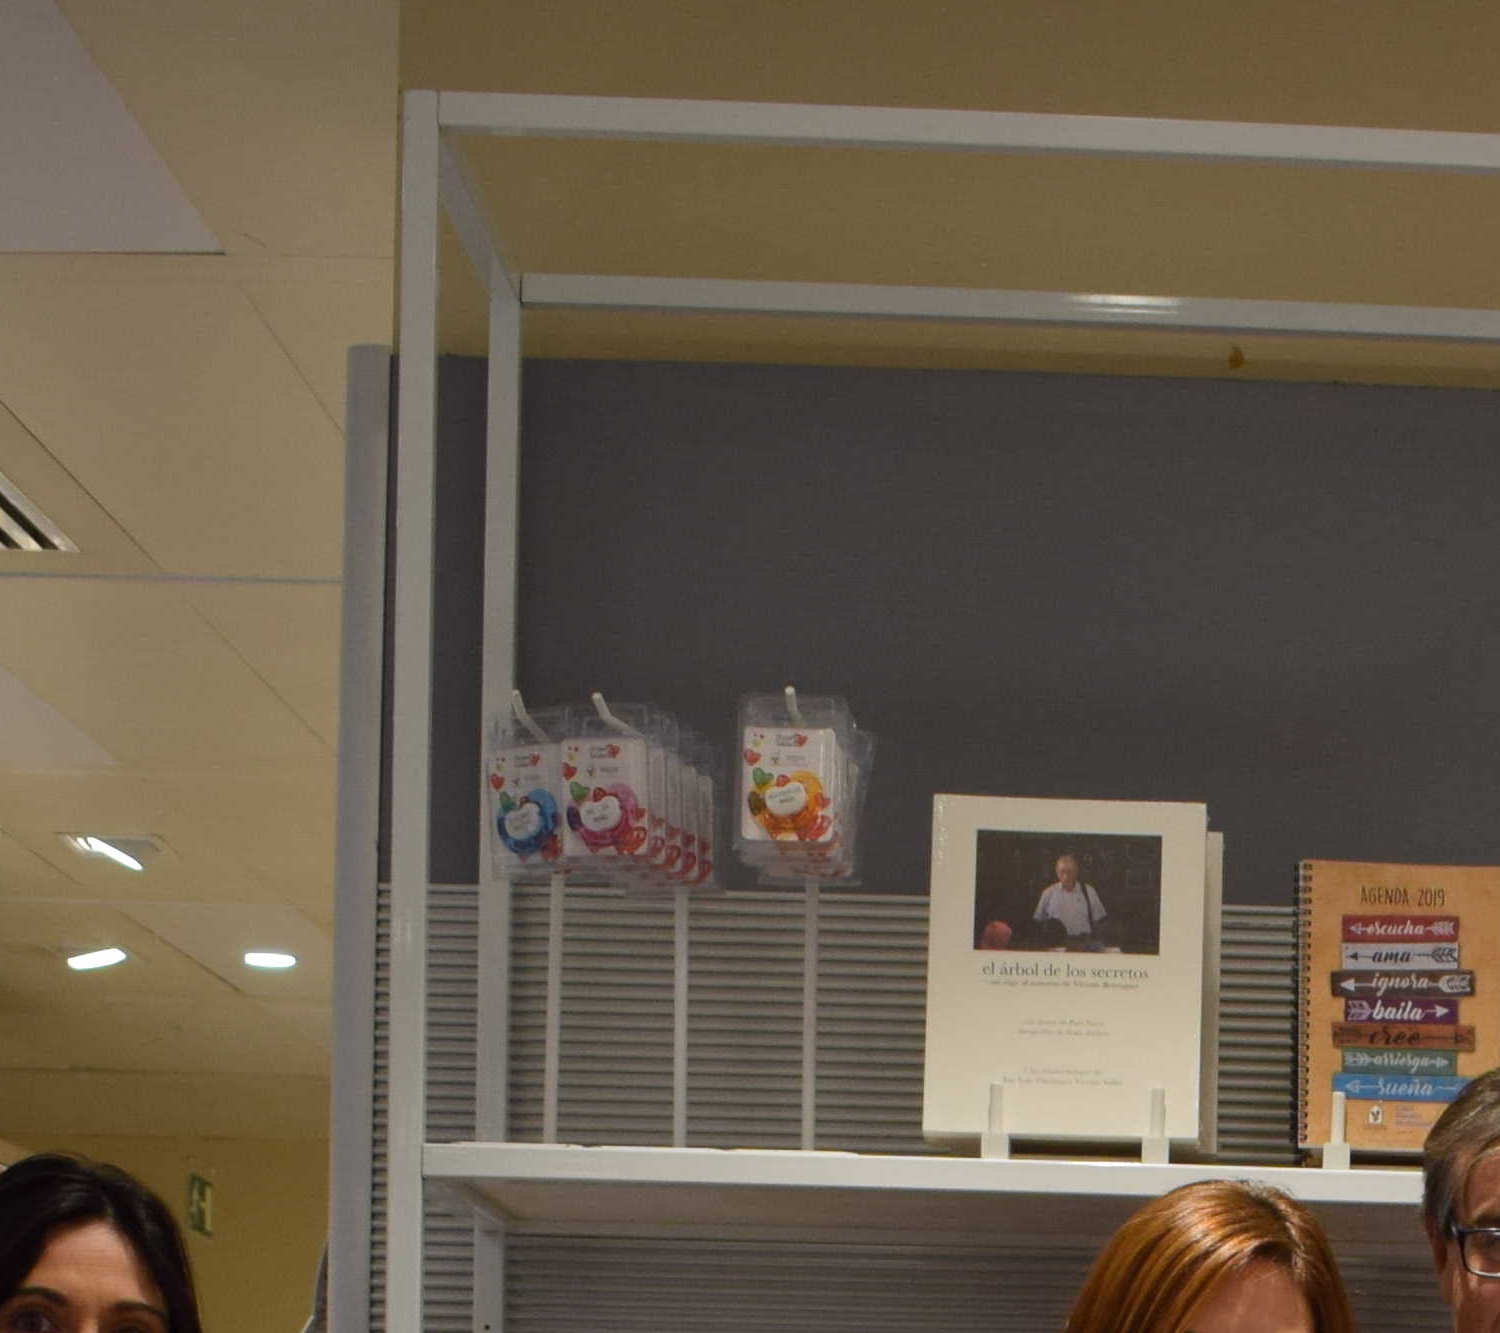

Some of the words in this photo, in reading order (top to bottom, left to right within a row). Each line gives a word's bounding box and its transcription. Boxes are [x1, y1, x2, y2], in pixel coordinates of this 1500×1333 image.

[1360, 885, 1410, 906] AGENDA
[1417, 887, 1445, 907] 2019
[1366, 919, 1426, 935] escucha
[1371, 950, 1413, 963] ama
[982, 961, 995, 976] el
[1000, 961, 1039, 977] árbol
[1043, 963, 1061, 978] de
[1067, 964, 1086, 978] los
[1091, 967, 1149, 979] secretos
[1371, 972, 1430, 997] ignora
[1371, 1000, 1426, 1021] baila
[1377, 1078, 1436, 1097] sueña
